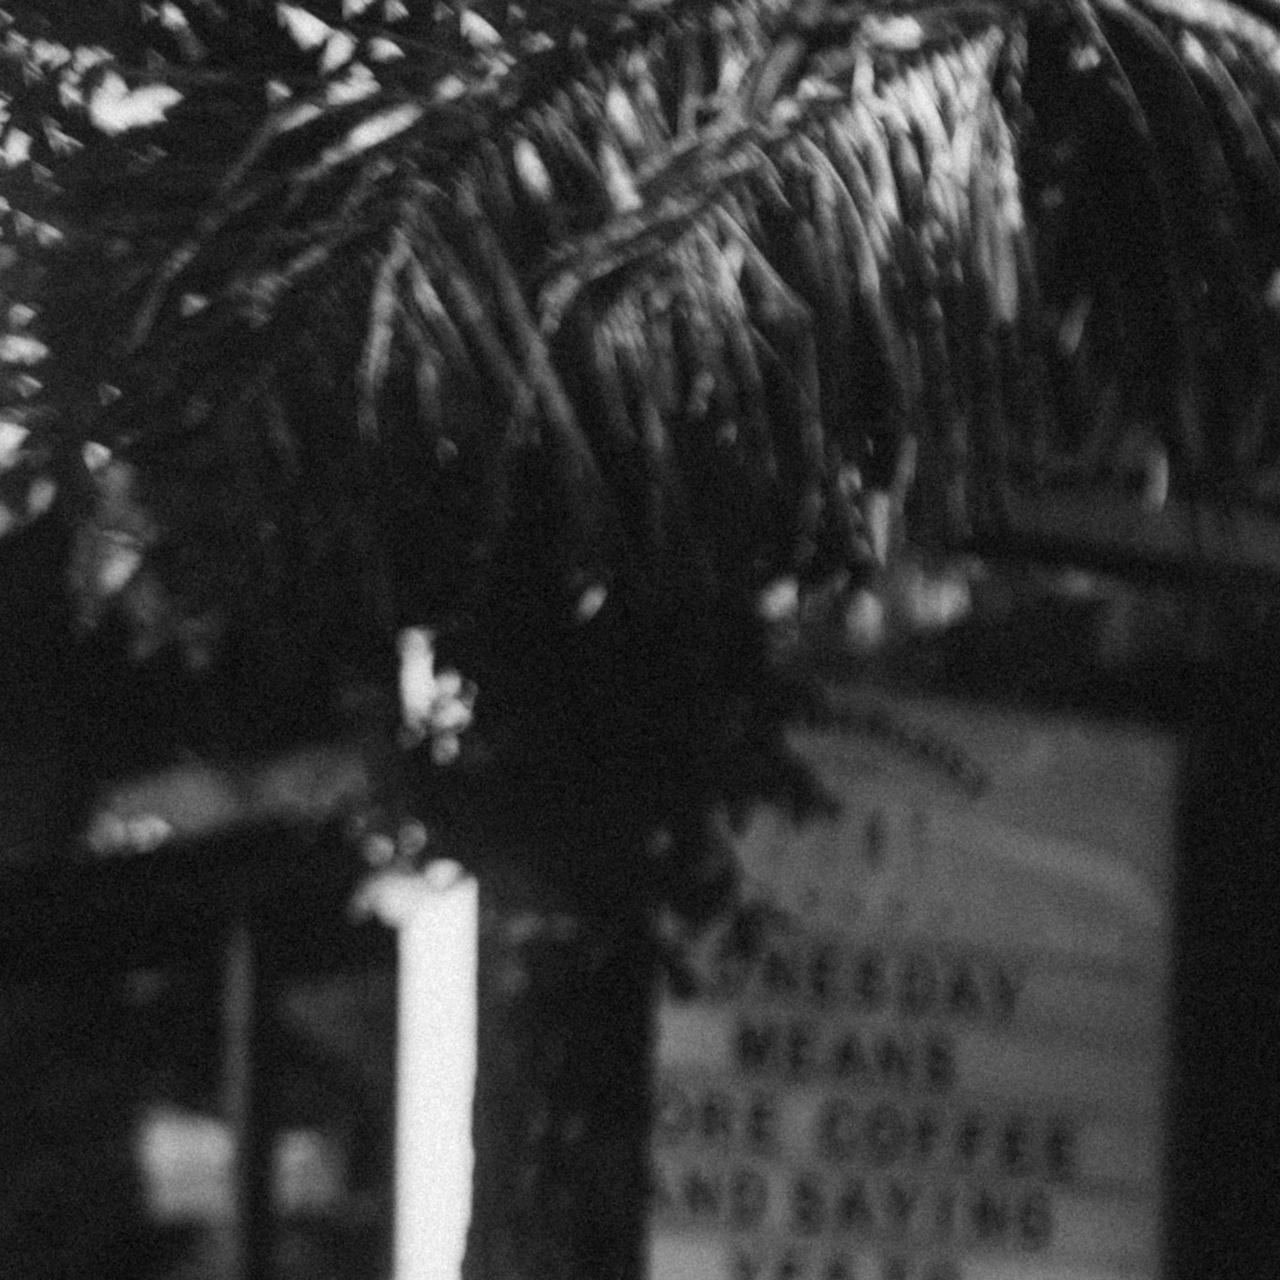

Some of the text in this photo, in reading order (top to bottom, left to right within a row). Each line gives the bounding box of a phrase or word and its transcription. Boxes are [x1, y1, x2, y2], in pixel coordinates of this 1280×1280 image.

[733, 1018, 958, 1092] MEANS
[648, 1086, 1078, 1180] ORE COFFEE
[790, 1172, 1056, 1252] SAYING
